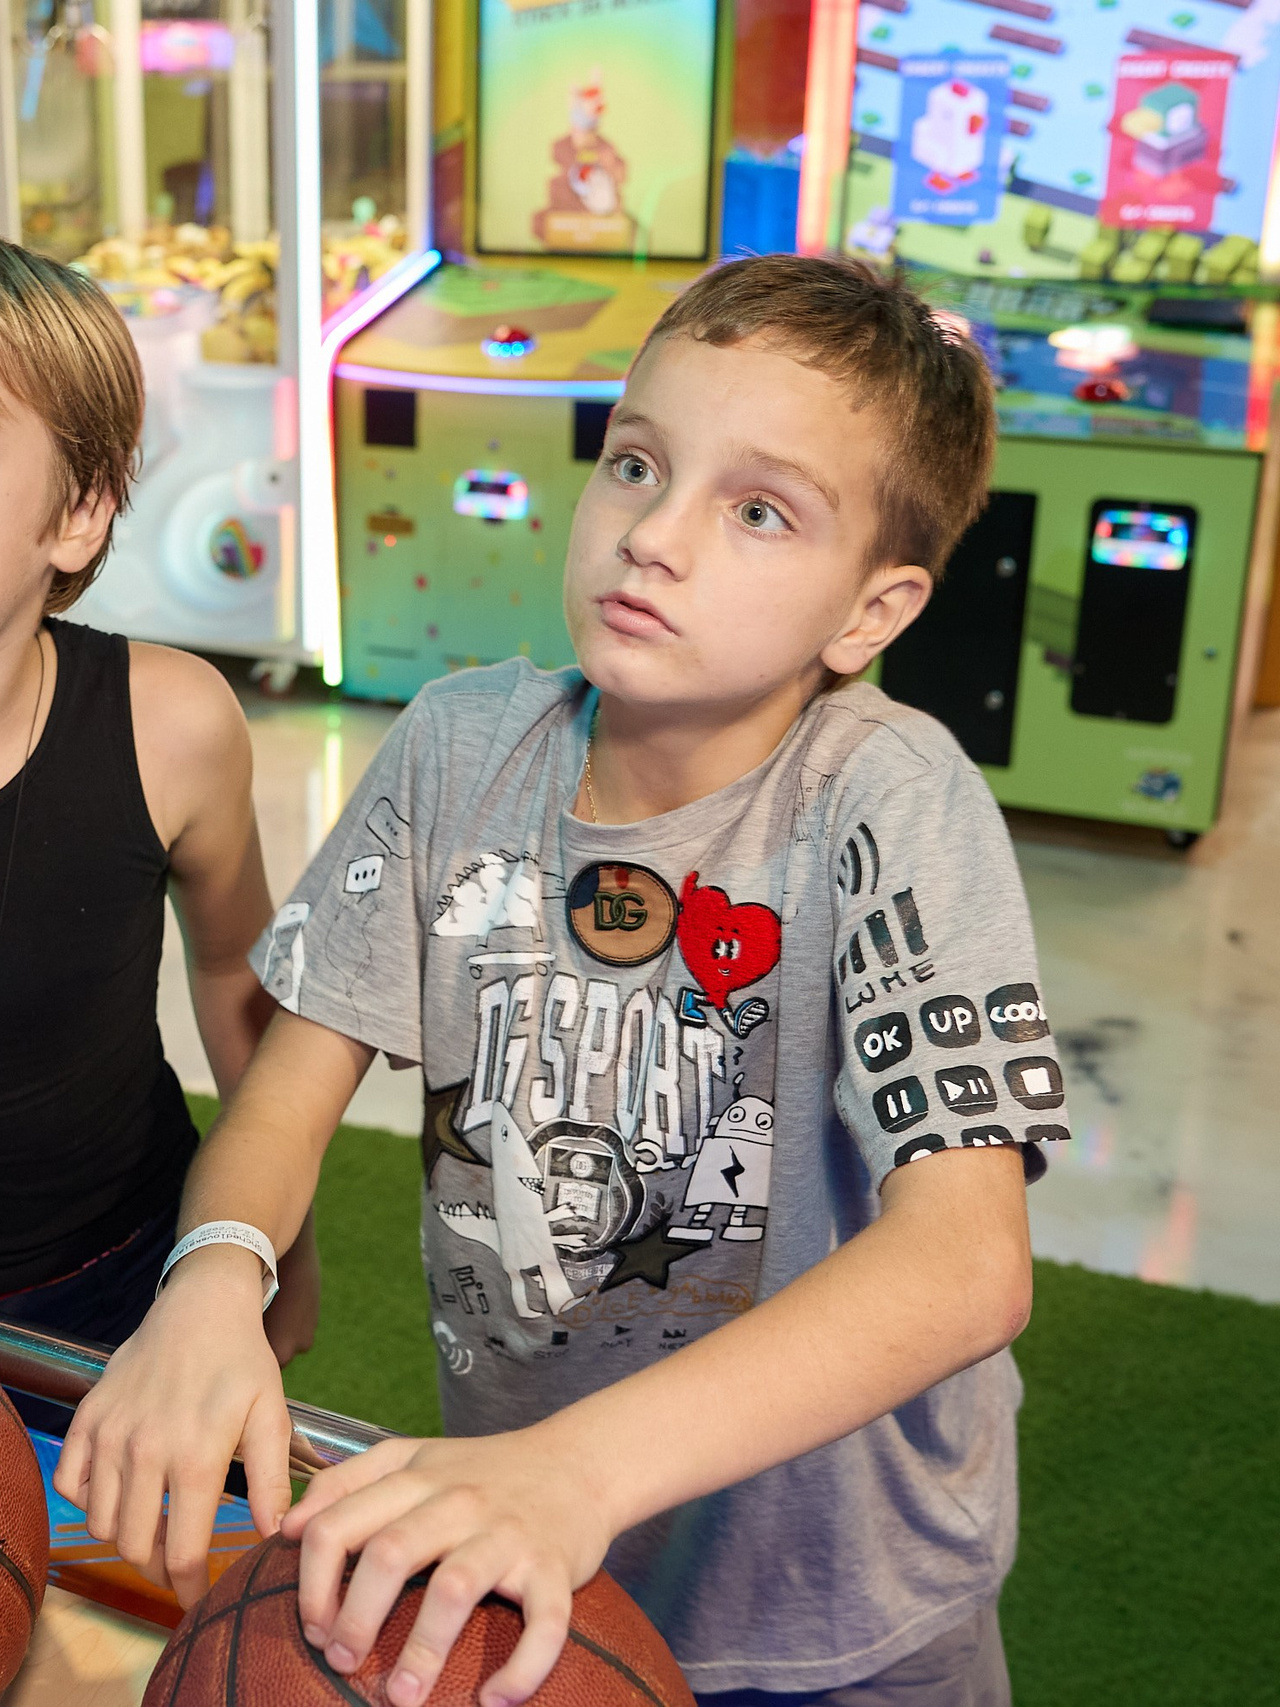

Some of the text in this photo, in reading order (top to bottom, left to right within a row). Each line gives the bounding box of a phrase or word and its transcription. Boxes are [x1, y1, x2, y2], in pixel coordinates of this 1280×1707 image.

[593, 890, 648, 932] DG
[928, 1006, 973, 1034] UP
[862, 1025, 903, 1059] OK
